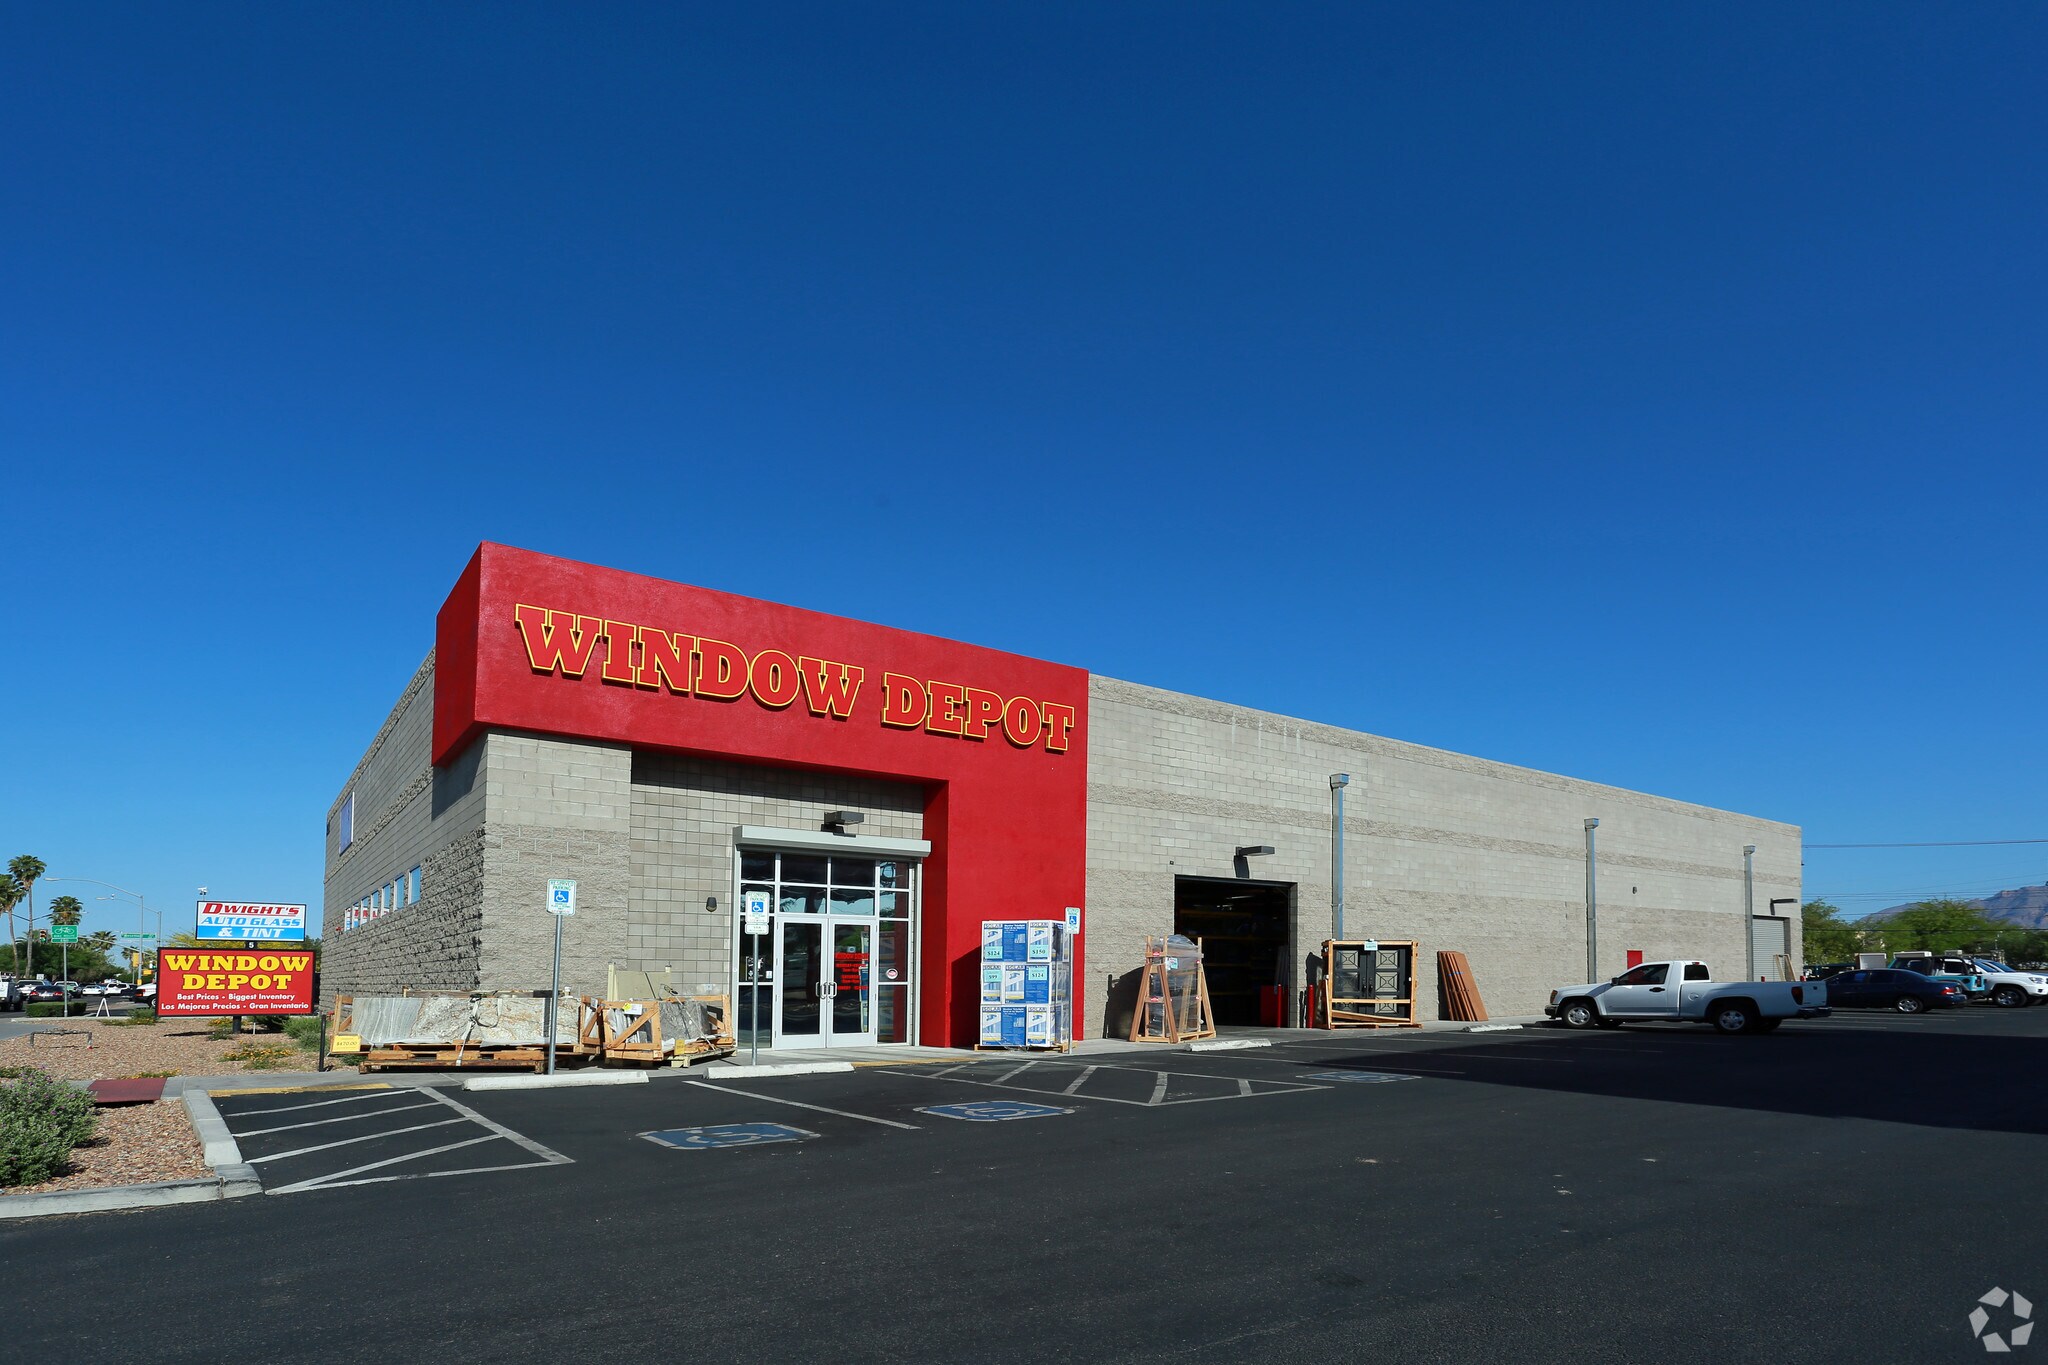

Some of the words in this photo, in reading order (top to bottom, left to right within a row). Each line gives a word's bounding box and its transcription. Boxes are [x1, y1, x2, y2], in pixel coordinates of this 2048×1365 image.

[514, 602, 865, 718] WINDOW
[880, 671, 1076, 752] DEPOT
[202, 902, 300, 915] DWIGHT'S
[201, 916, 247, 926] AUTO
[250, 917, 301, 927] GLASS
[217, 927, 233, 937] &
[242, 927, 285, 938] TINT
[164, 954, 310, 972] WINDOW
[182, 974, 292, 990] DEPOT
[228, 993, 257, 1002] Biggest
[259, 993, 295, 1001] Inventory
[177, 1003, 210, 1011] Mejores
[212, 1002, 241, 1010] Precios
